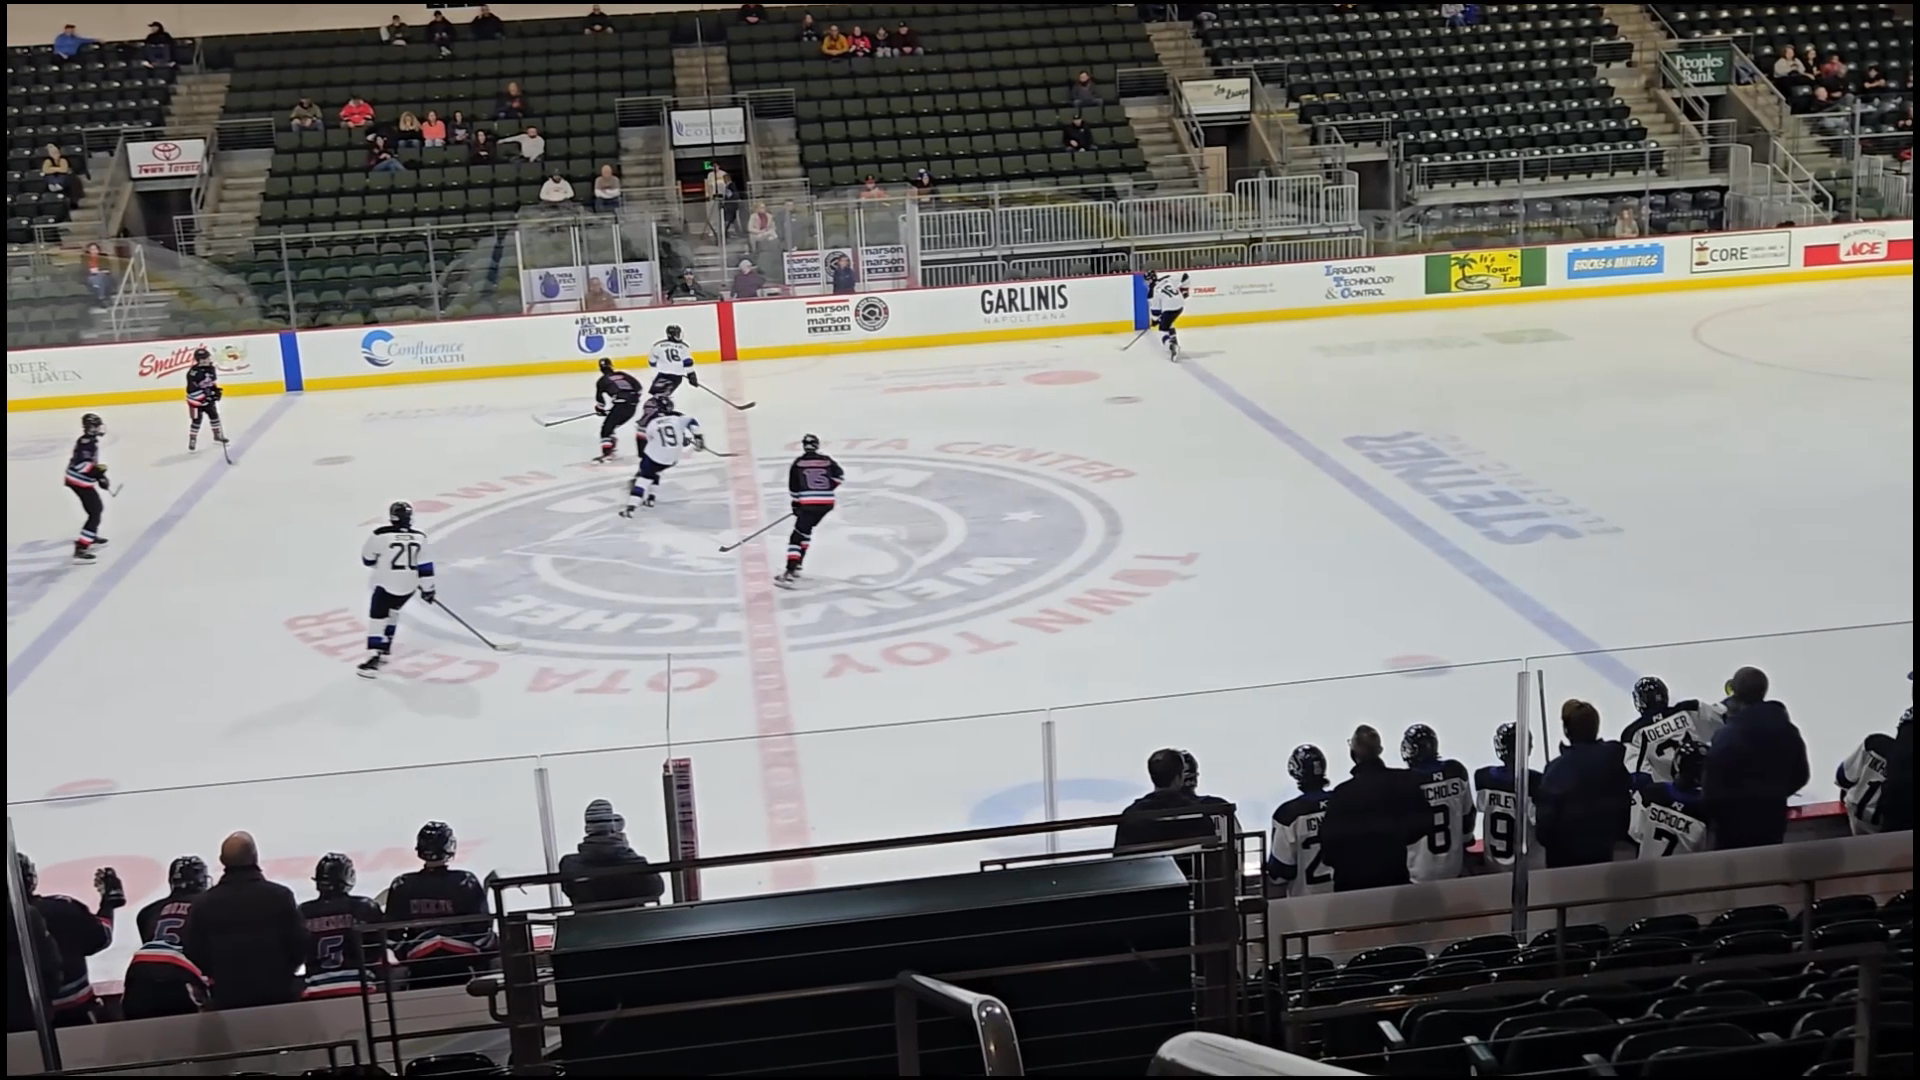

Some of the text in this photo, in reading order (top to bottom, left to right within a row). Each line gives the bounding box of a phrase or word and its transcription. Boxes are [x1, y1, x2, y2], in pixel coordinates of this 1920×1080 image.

[1675, 53, 1724, 72] Peoples
[1682, 68, 1716, 83] Bank
[1709, 247, 1749, 262] CORE
[1845, 242, 1882, 256] ACE
[1480, 253, 1496, 263] It's
[1574, 258, 1606, 271] BRICKS
[1613, 254, 1659, 268] MINIFIGS
[1324, 265, 1376, 277] IRRIGATION
[1485, 264, 1512, 274] Your
[1333, 275, 1395, 288] TECHNOLOGY
[1501, 273, 1521, 283] Tan
[981, 284, 1068, 315] GARLINIS
[1325, 287, 1386, 300] & CONTROL
[806, 304, 850, 315] marson
[580, 316, 617, 326] PLUMB
[807, 315, 851, 326] marson
[983, 312, 1066, 325] NAPOLETANA
[581, 325, 630, 336] PERFECT
[387, 341, 465, 360] Confluence
[420, 353, 465, 365] HEALTH
[9, 360, 48, 374] DEER
[30, 369, 83, 384] HAVEN
[658, 425, 678, 447] 19
[932, 440, 1139, 483] CENTER
[388, 541, 421, 571] 20
[1647, 714, 1690, 743] DEGLER
[1649, 807, 1694, 835] SCHOCK
[1427, 803, 1452, 856] 8
[1489, 811, 1515, 860] 9
[1653, 826, 1679, 858] 7
